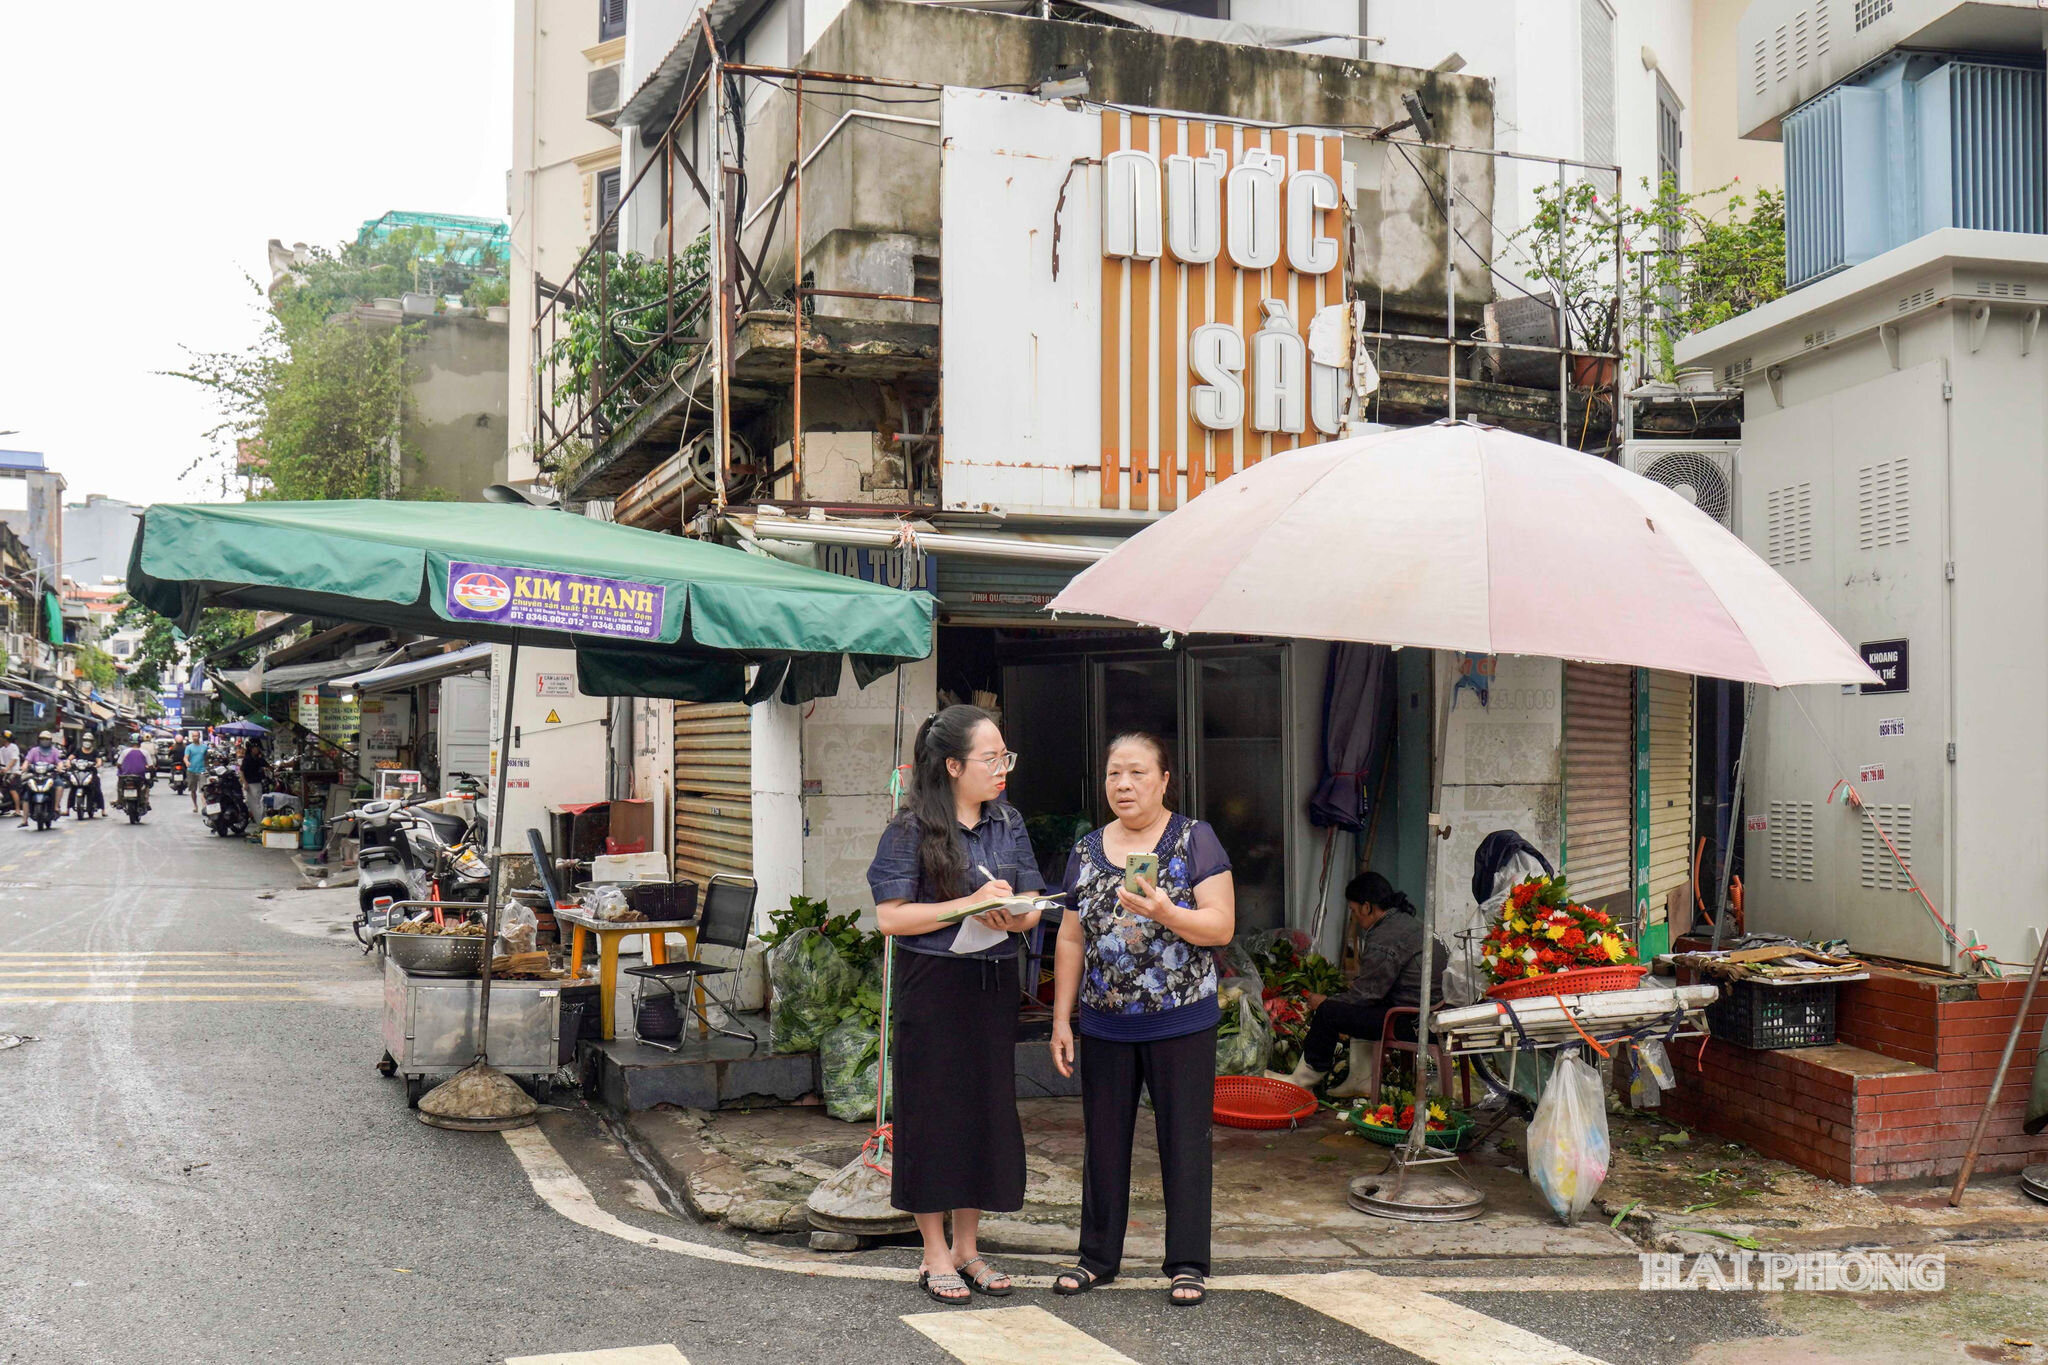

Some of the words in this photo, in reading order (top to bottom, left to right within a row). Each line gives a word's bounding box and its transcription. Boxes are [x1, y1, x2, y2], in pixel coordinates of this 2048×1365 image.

[1102, 148, 1339, 275] NƯỚC
[461, 585, 506, 598] KT
[513, 576, 562, 602] KIM
[568, 582, 653, 613] THANH
[1869, 650, 1898, 664] KHOANG
[1882, 664, 1896, 680] THẾ
